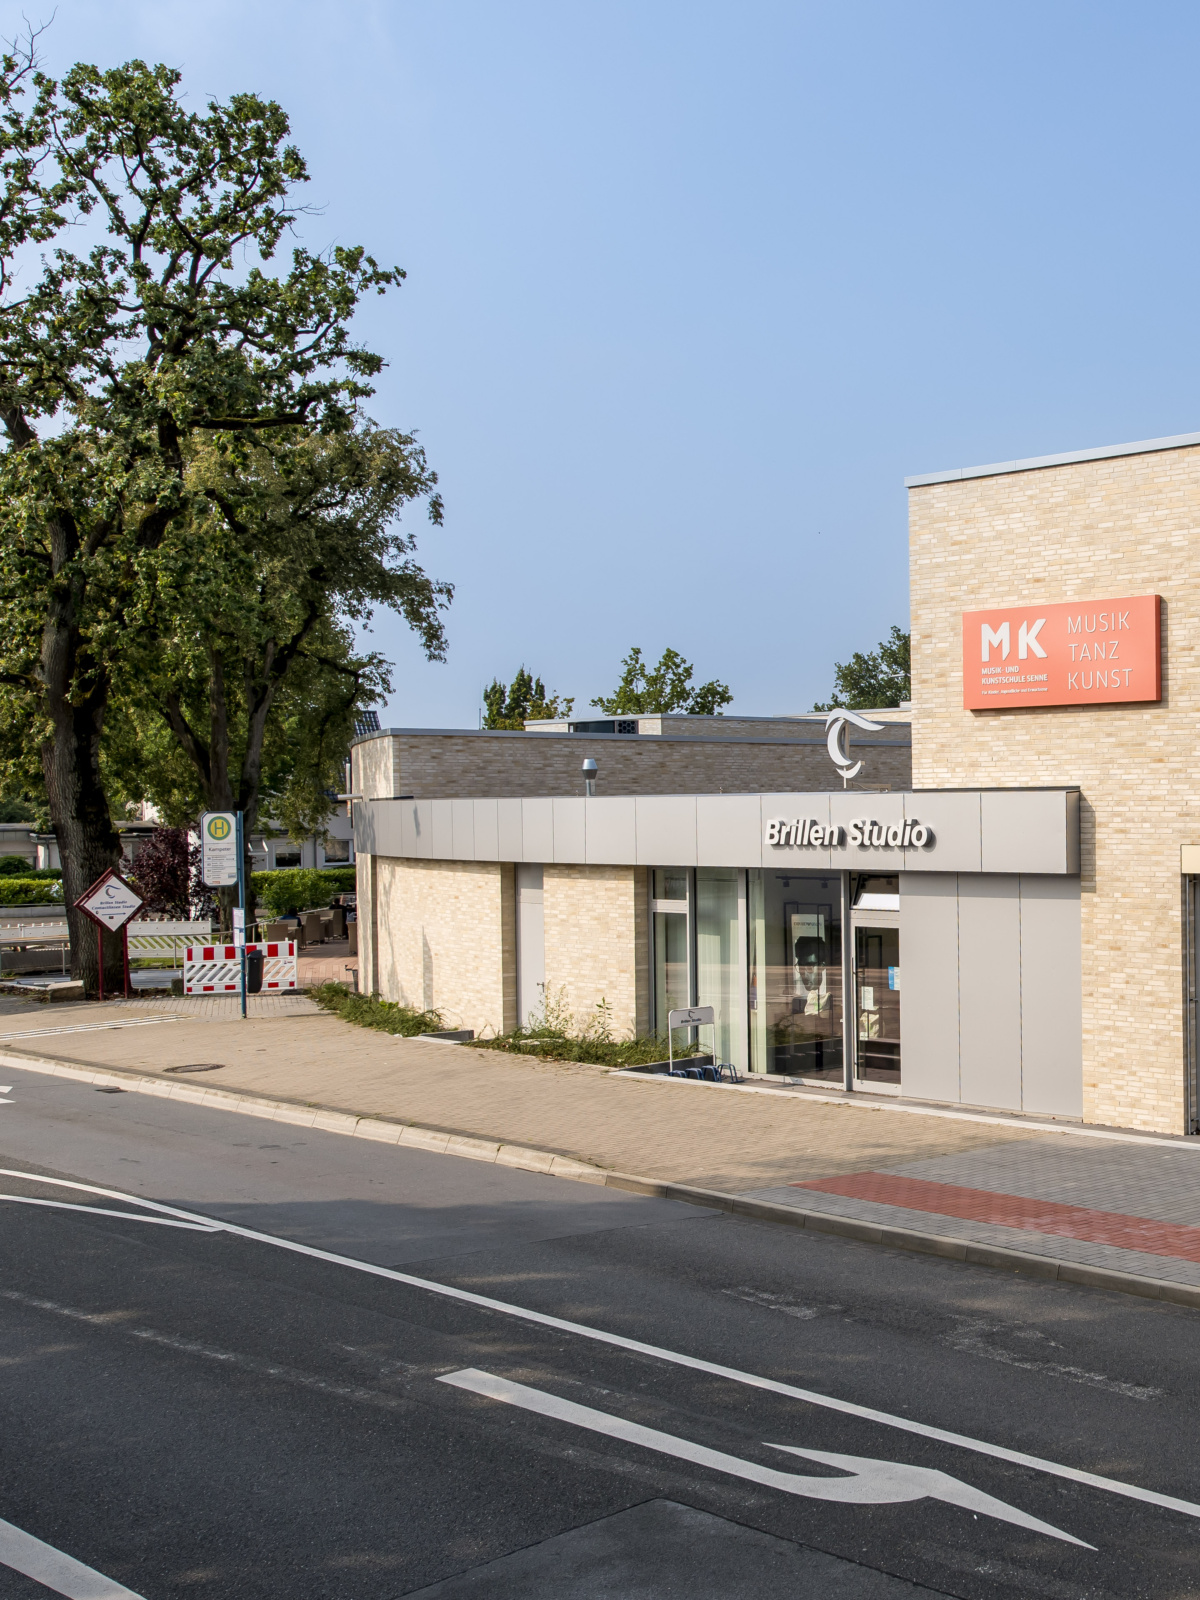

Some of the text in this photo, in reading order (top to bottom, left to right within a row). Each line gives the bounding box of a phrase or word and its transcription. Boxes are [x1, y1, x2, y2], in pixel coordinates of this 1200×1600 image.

[1067, 611, 1131, 634] MUSIK
[981, 618, 1048, 662] MK
[1068, 640, 1120, 662] TANZ
[981, 673, 1048, 685] KUNSTSCHULE SENNE
[1005, 665, 1020, 674] UND
[1067, 668, 1134, 690] KUNST
[214, 821, 225, 835] H
[764, 818, 929, 847] Brillen Studio
